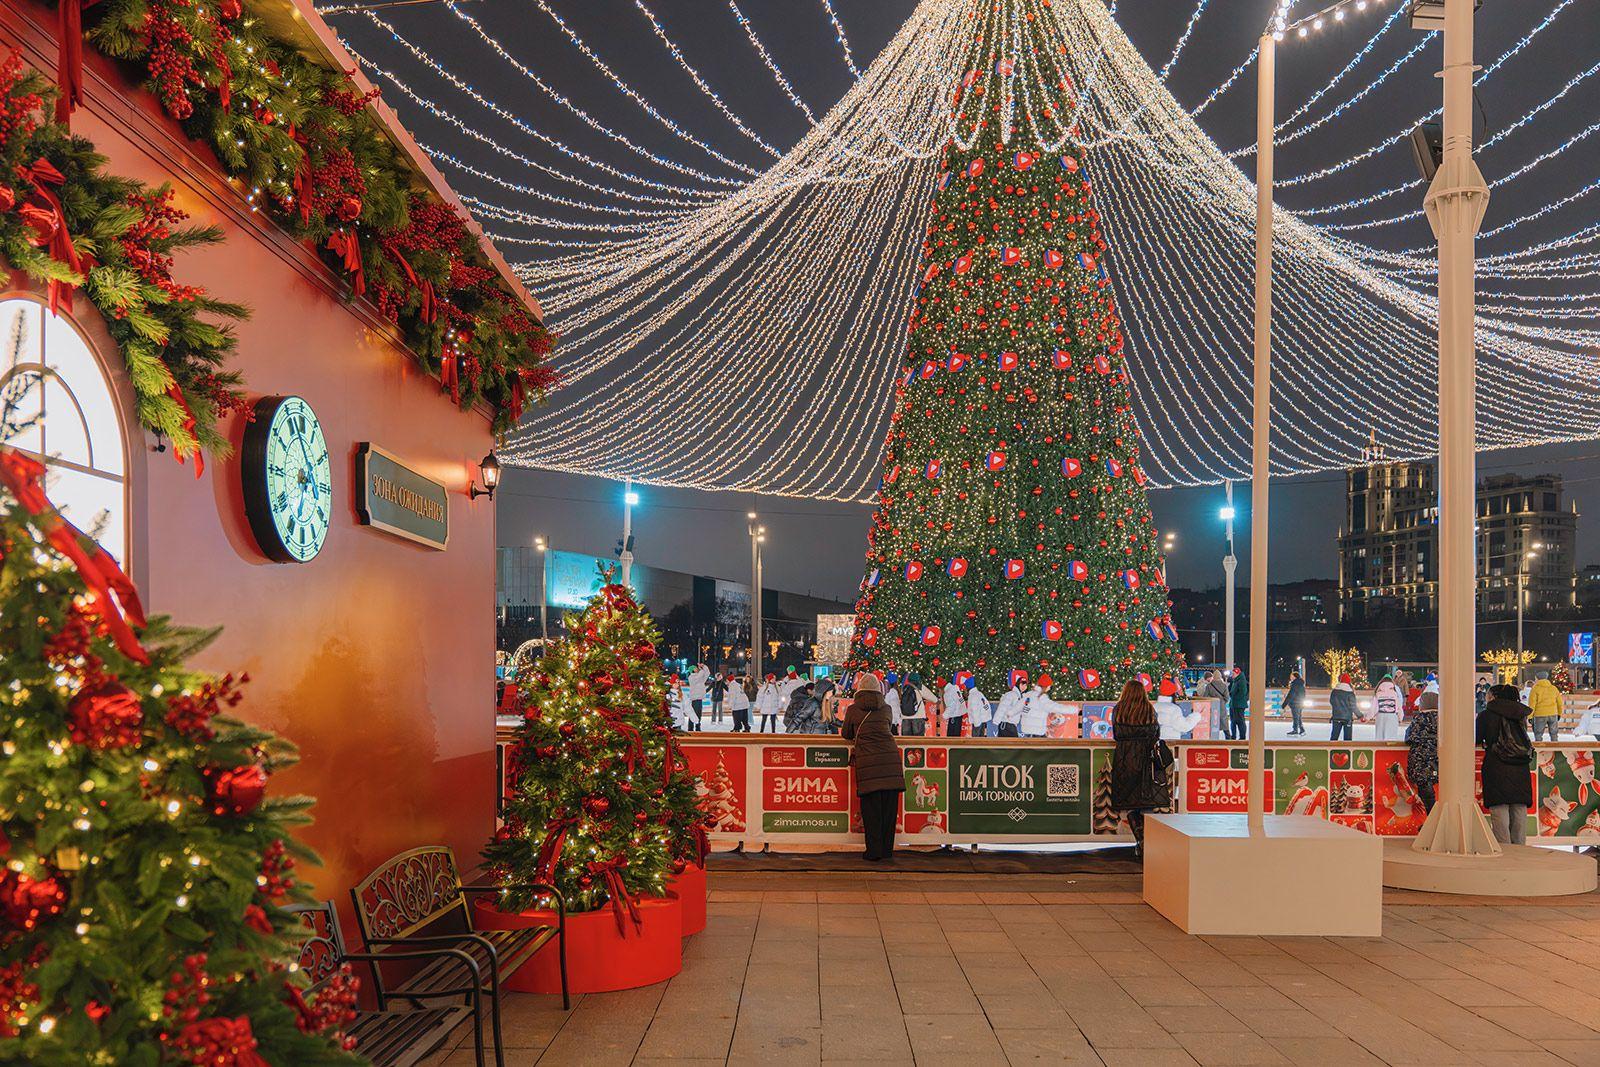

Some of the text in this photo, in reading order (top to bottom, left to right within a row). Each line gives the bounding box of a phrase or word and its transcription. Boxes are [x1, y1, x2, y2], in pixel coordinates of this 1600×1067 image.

[372, 474, 444, 523] ЗОНА ОЖИДАНИЯ
[959, 764, 1035, 789] КАТОК
[773, 776, 838, 793] ЗИМА
[1197, 777, 1249, 794] ЗИМ
[773, 794, 839, 804] В МОСКВЕ
[959, 790, 1035, 802] ПАРК ГОРЬКОГО
[1197, 795, 1249, 805] В МОСК
[773, 817, 838, 827] zima.mos.ru
